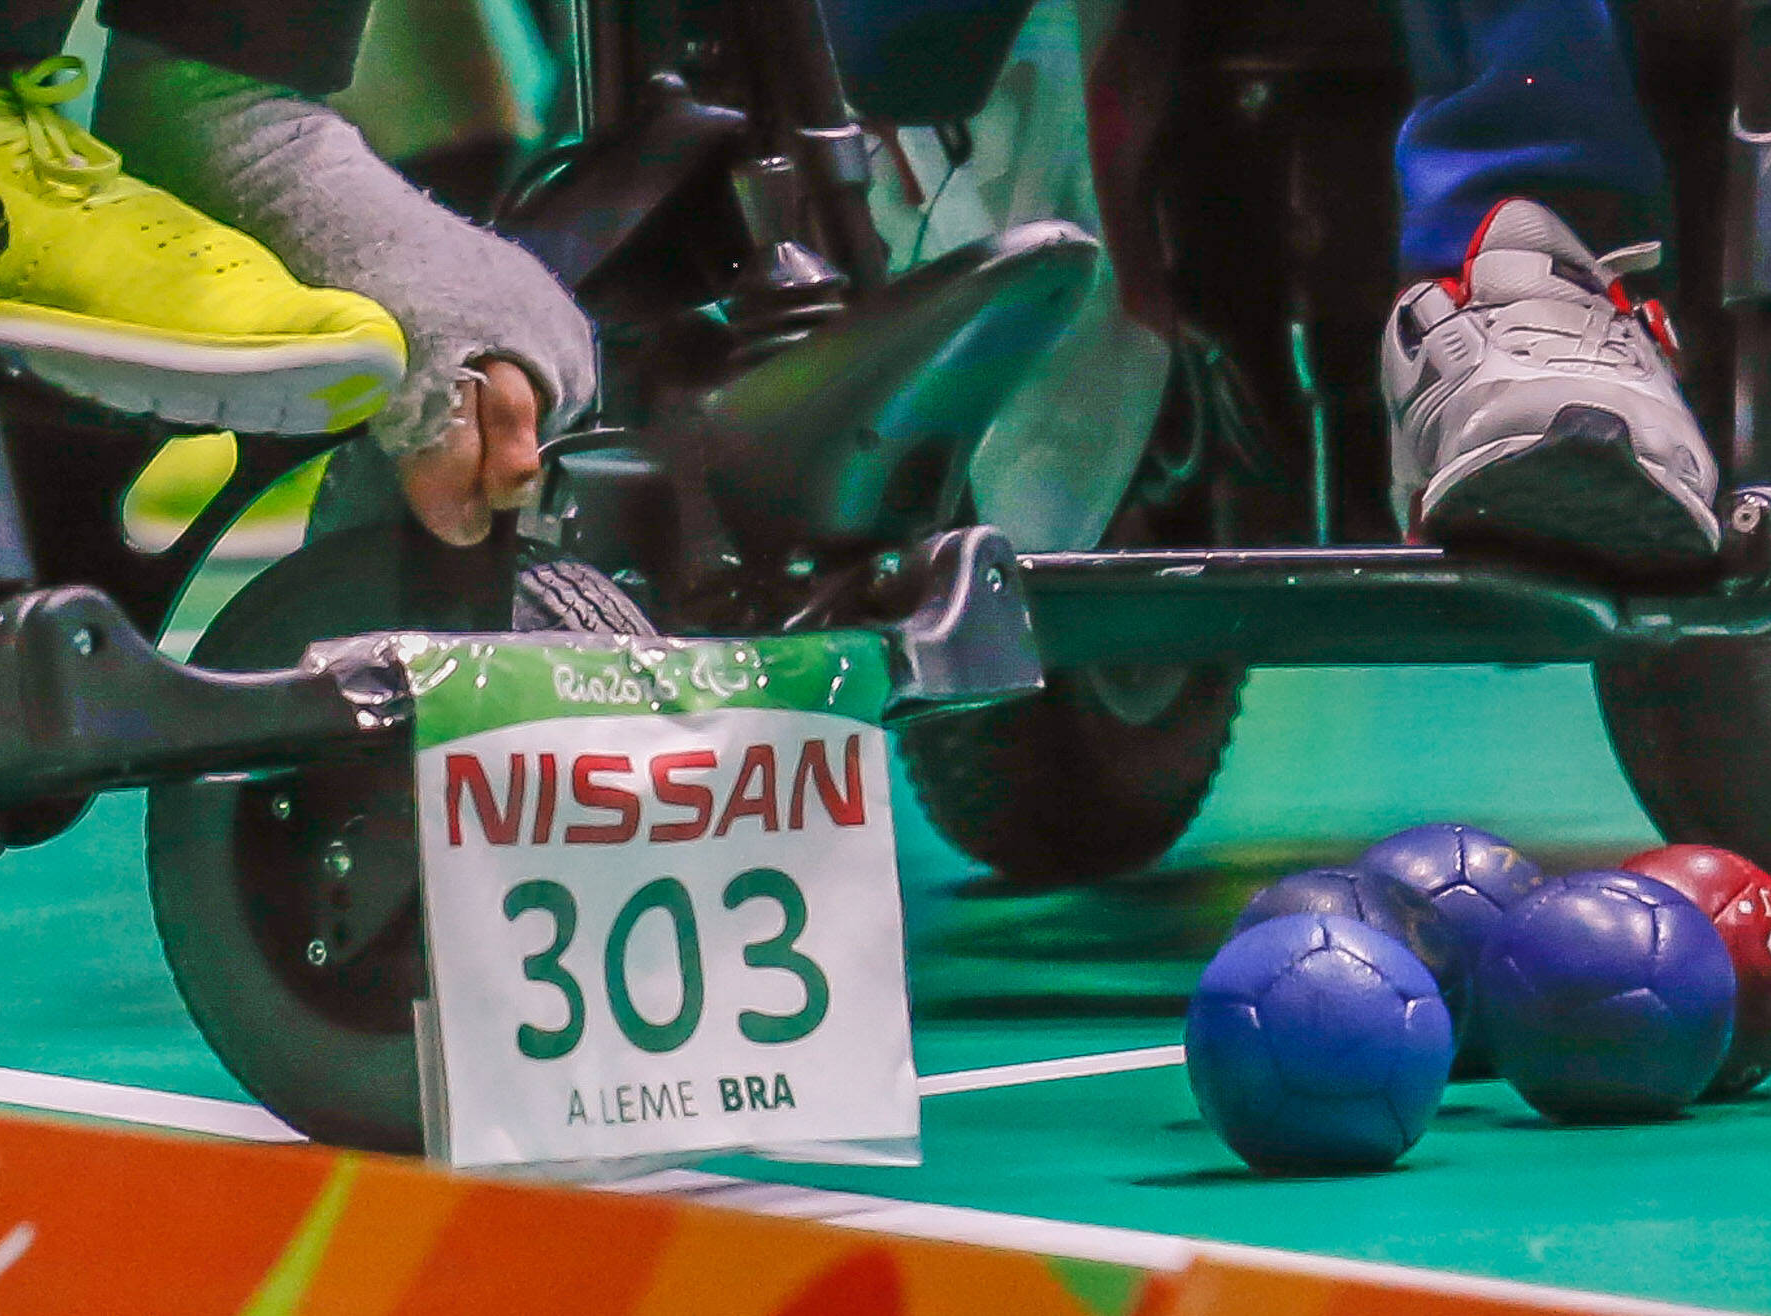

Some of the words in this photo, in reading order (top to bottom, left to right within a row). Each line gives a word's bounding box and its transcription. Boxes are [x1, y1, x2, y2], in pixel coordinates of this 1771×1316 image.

[445, 734, 866, 846] NISSAN
[503, 867, 830, 1060] 303
[600, 1080, 699, 1124] LEME
[718, 1072, 796, 1112] BRA
